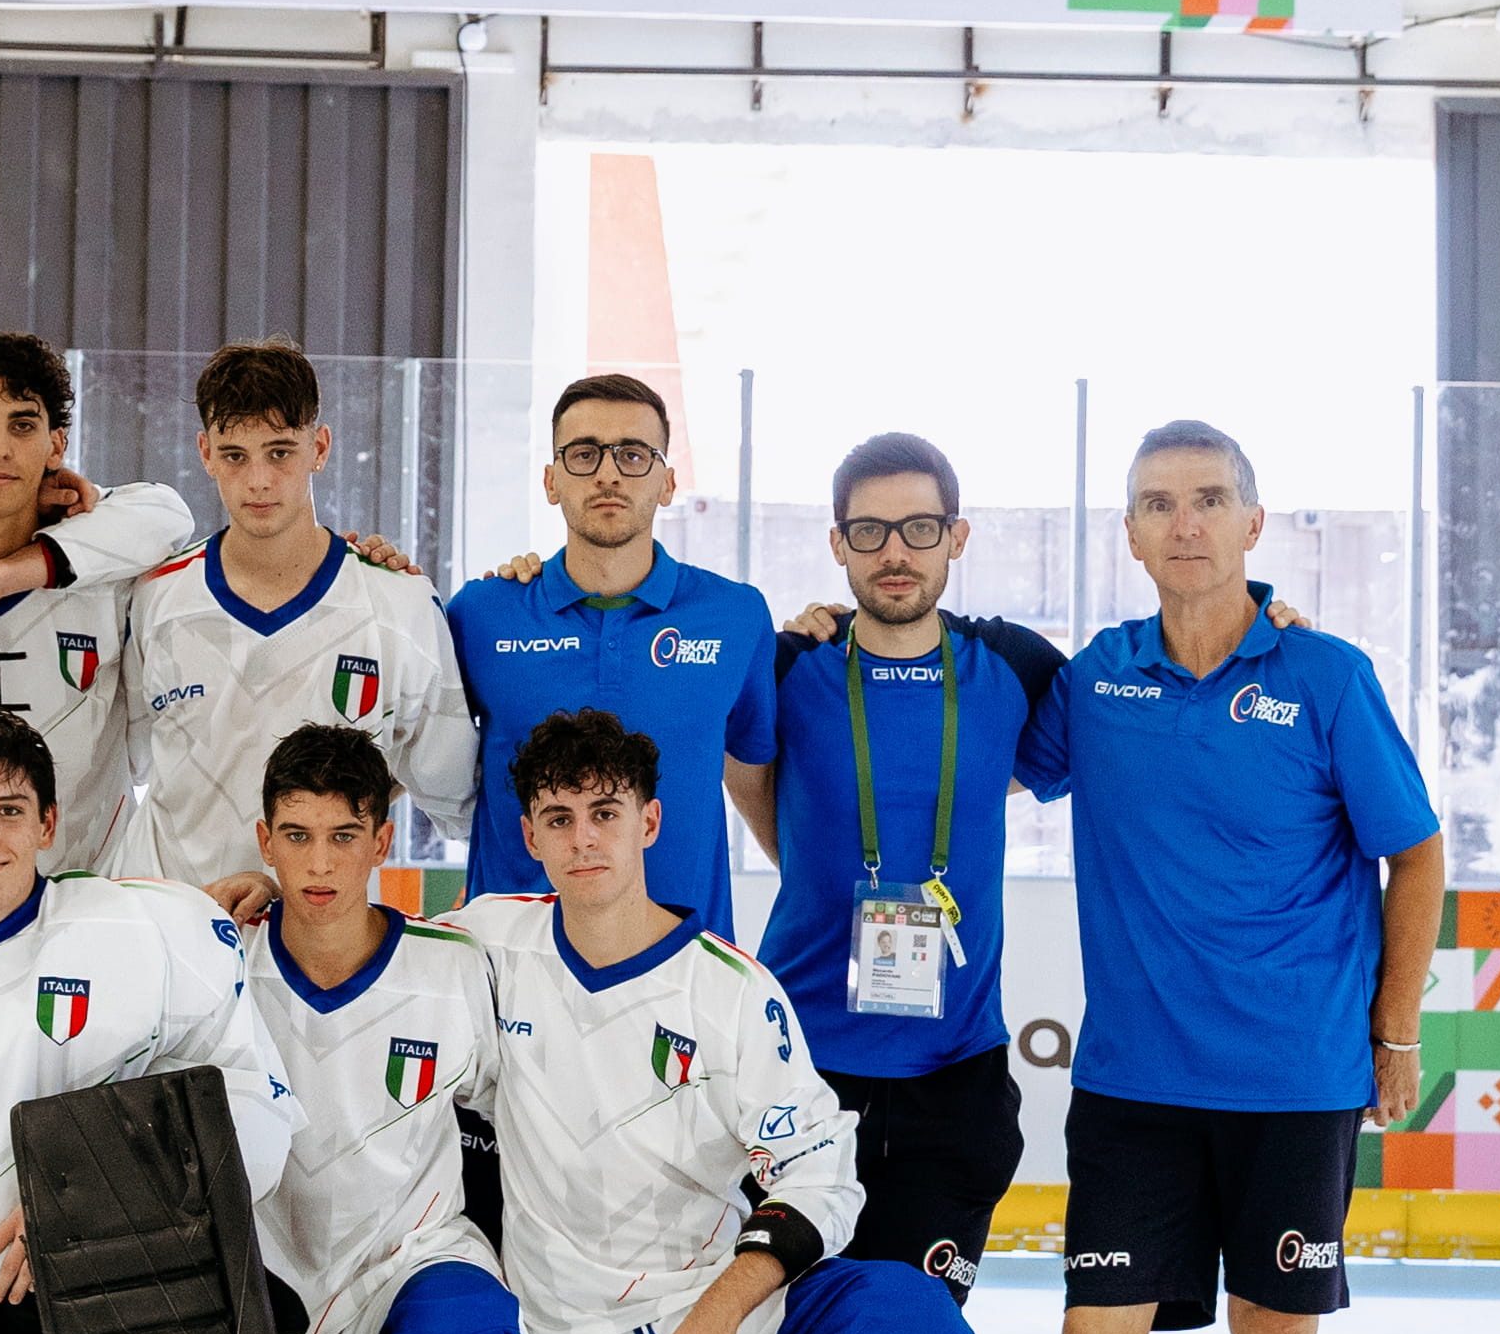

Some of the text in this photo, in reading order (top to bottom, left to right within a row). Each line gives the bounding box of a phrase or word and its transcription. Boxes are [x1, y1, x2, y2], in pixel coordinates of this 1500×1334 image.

[495, 636, 581, 653] GIVOVA
[678, 639, 723, 653] SKATE
[341, 658, 377, 675] ITALIA
[675, 651, 718, 665] ITALIA
[1094, 680, 1162, 700] GIVOVA
[1256, 695, 1301, 718] SKATE
[1251, 706, 1297, 727] ITALIA
[43, 980, 86, 995] ITALIA
[764, 997, 792, 1064] 3
[394, 1042, 434, 1057] ITALIA
[1302, 1241, 1339, 1259] SKATE
[1298, 1253, 1338, 1269] ITALIA
